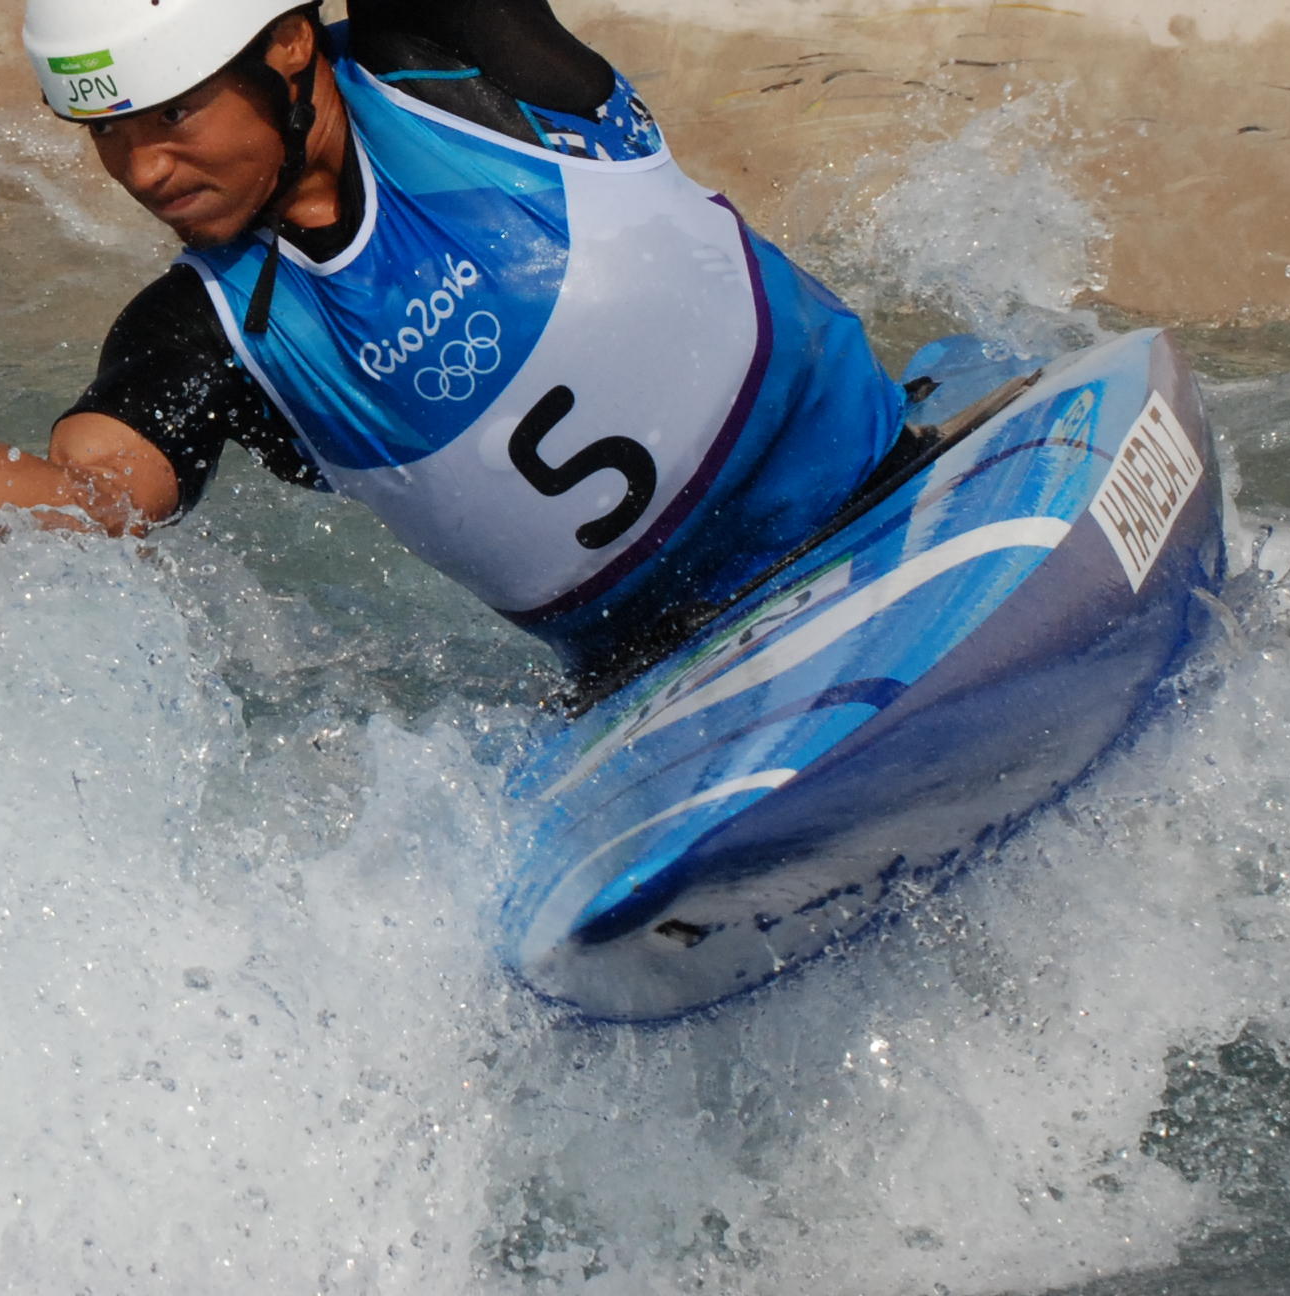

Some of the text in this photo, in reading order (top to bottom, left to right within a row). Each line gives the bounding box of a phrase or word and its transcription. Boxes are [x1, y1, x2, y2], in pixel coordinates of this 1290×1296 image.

[69, 74, 118, 102] JPN
[508, 384, 657, 549] 5
[1099, 424, 1189, 572] HANEDA
